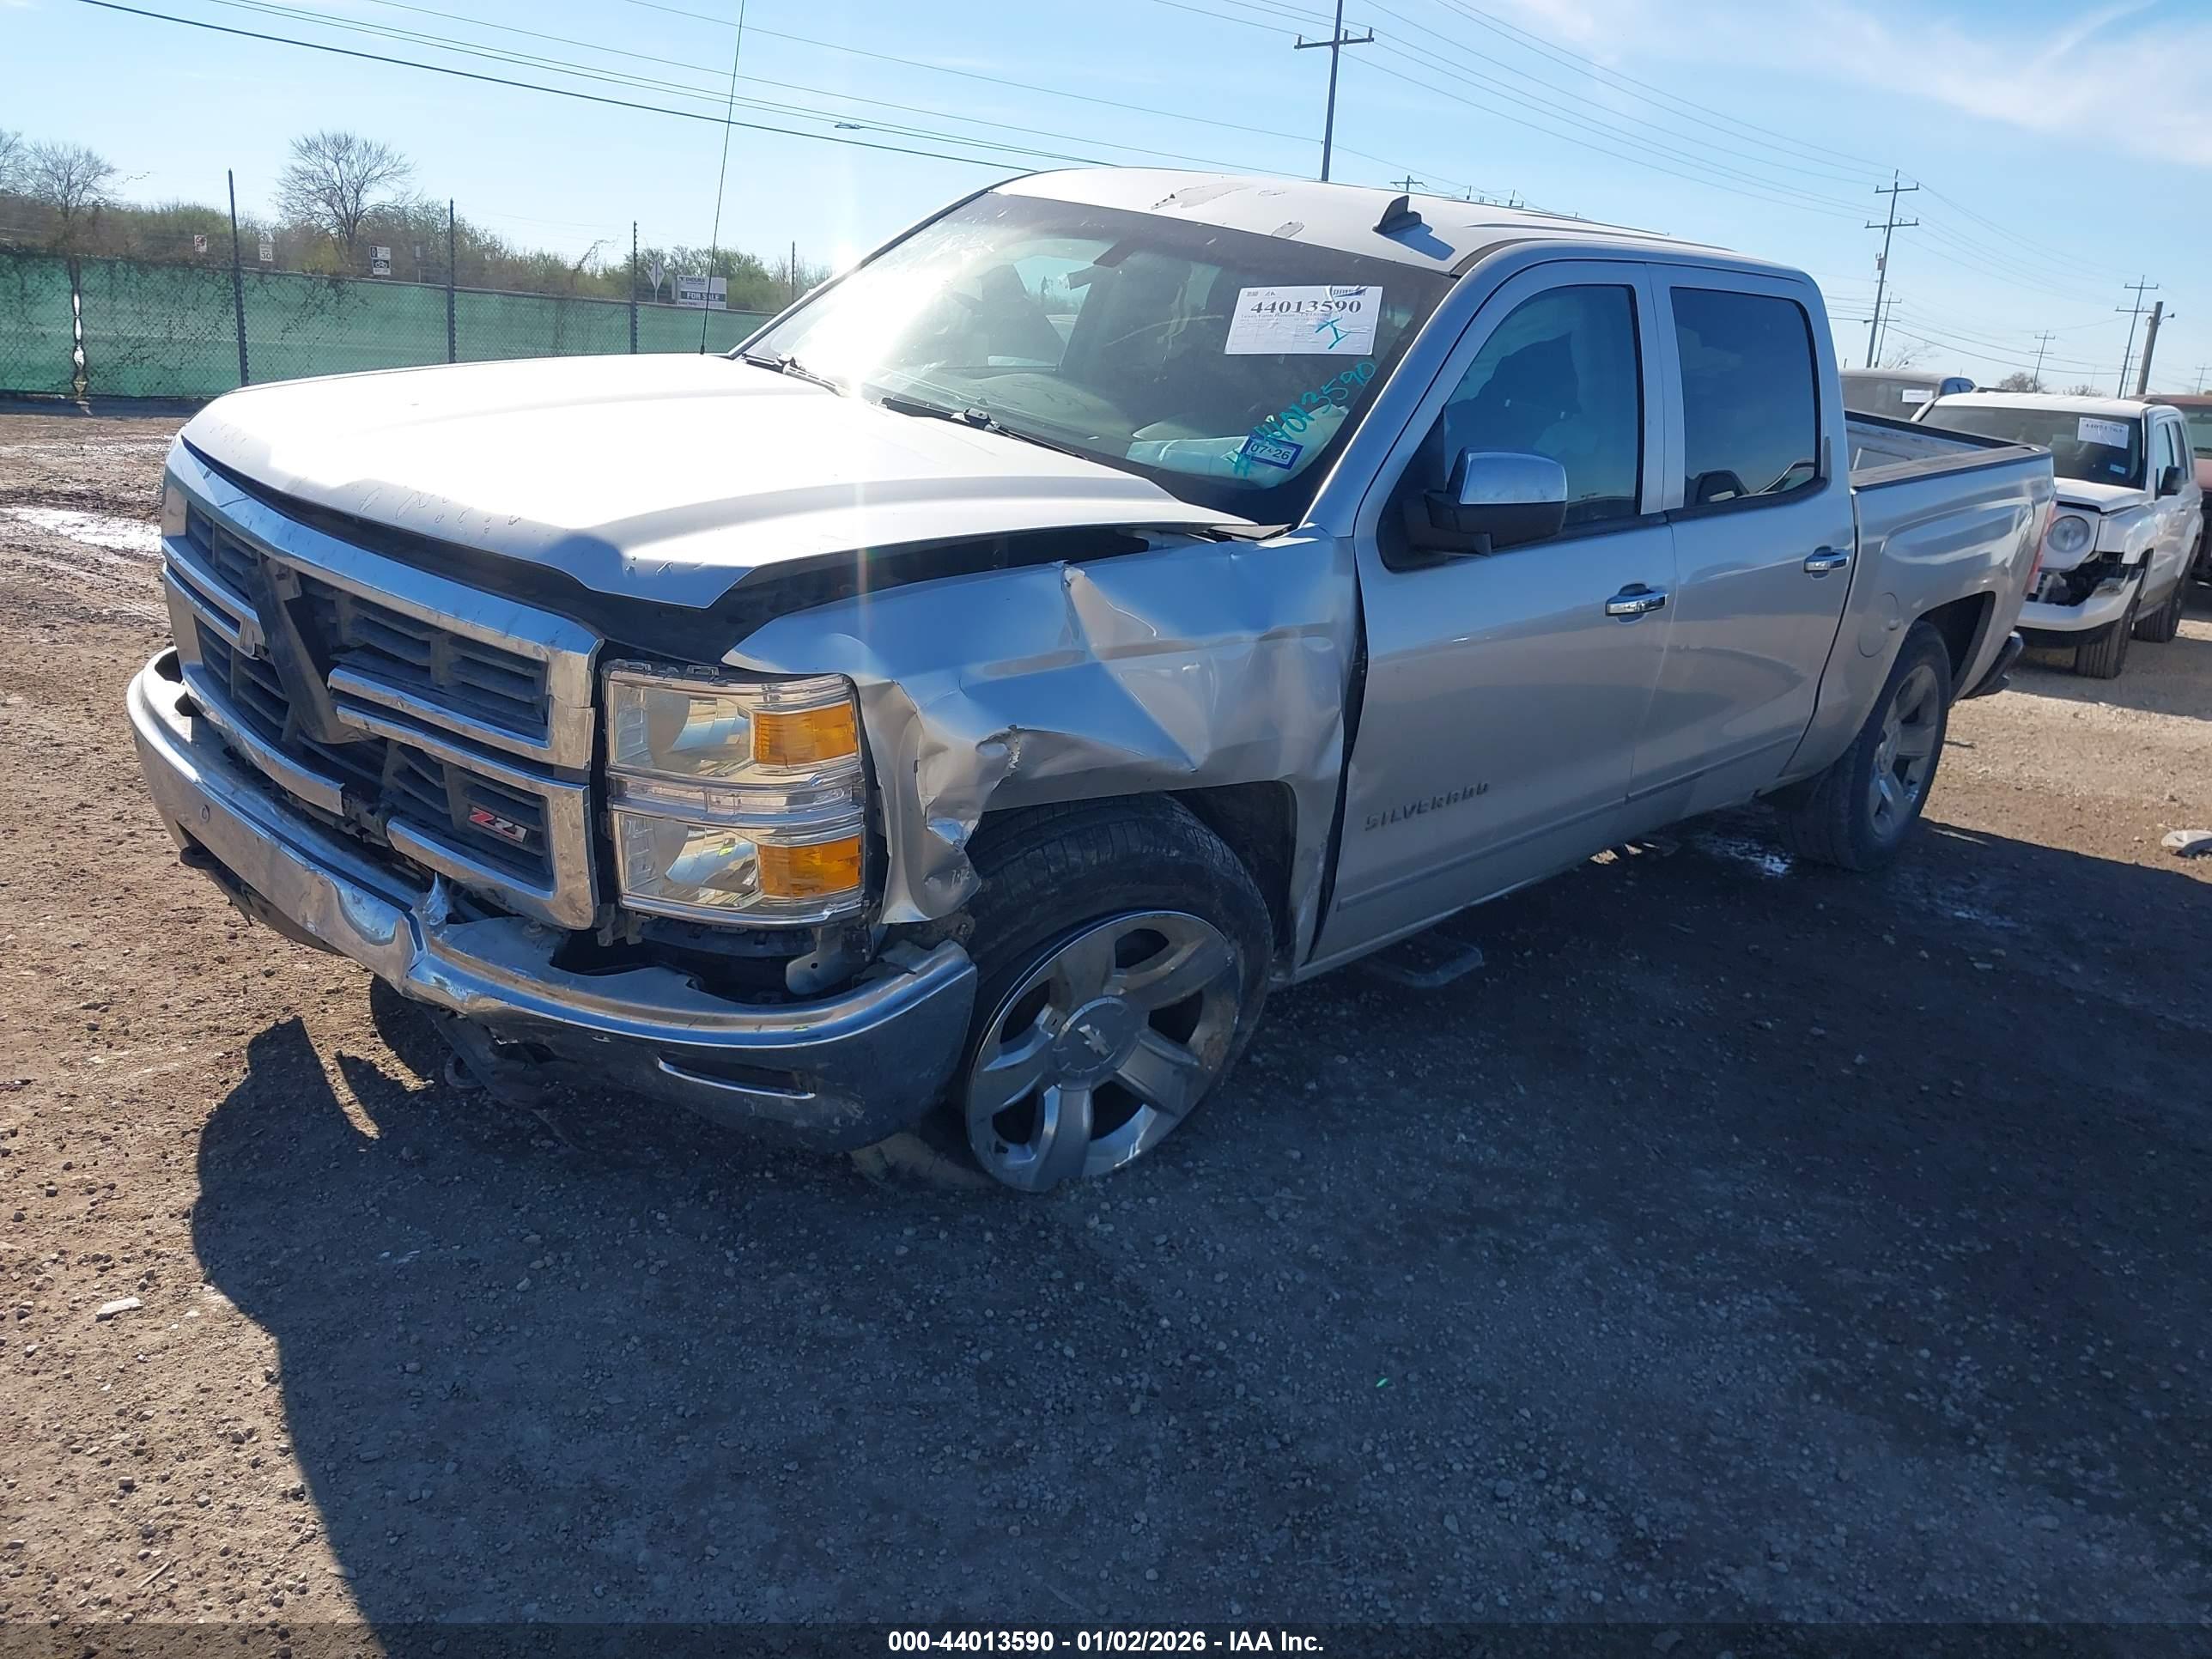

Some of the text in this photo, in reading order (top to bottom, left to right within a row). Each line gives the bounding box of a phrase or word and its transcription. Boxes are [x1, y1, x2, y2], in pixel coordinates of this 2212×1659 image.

[687, 292, 702, 301] FOR
[1250, 300, 1362, 313] 44013590
[1250, 443, 1291, 460] 07 26
[1364, 781, 1489, 831] SILVERADO
[468, 806, 528, 843] Z71
